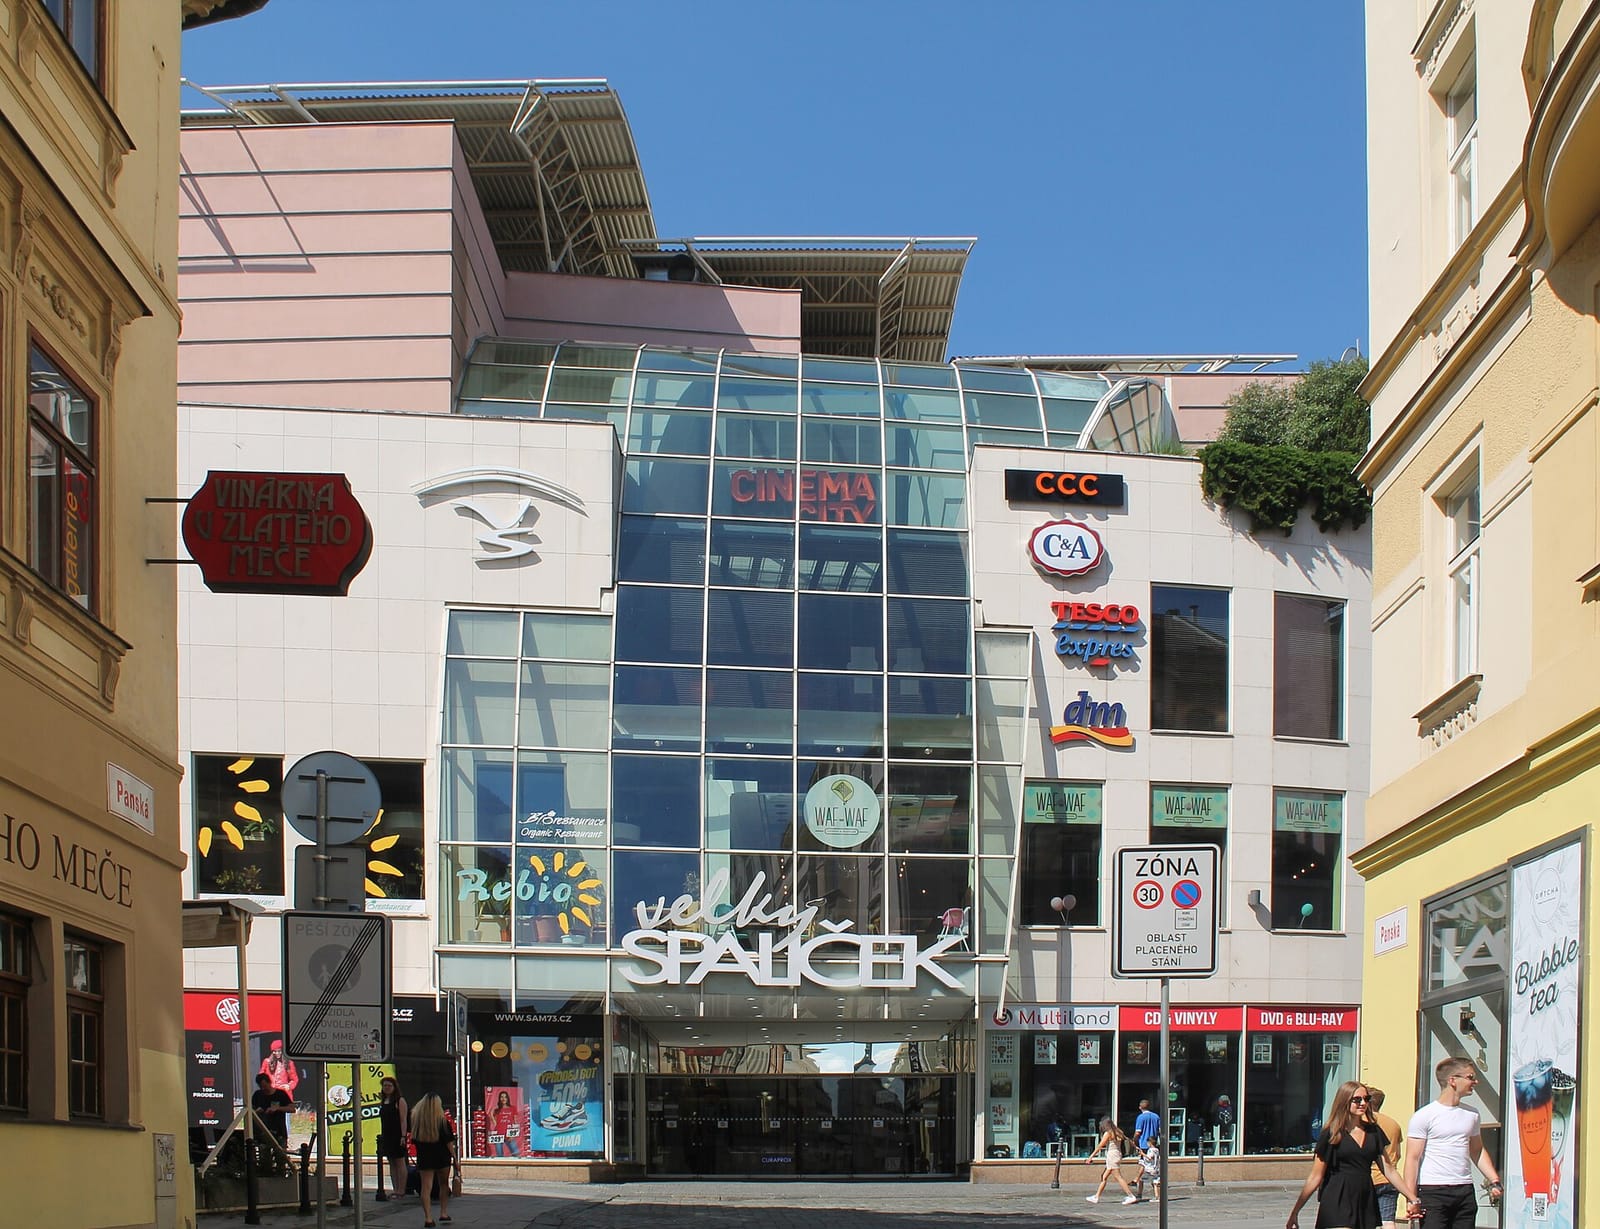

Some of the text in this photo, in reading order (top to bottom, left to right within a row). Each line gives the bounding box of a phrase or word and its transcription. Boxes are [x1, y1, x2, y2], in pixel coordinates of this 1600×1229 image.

[215, 477, 334, 511] VINÁRNA
[731, 469, 876, 502] CINEMA
[1035, 472, 1099, 496] CCC
[221, 510, 350, 544] ZLATÉHO
[64, 491, 80, 596] galerie
[1043, 534, 1091, 560] C&A
[229, 545, 311, 577] MEČE
[1050, 601, 1139, 624] TESCO
[1055, 633, 1134, 663] expres
[1064, 691, 1123, 726] dm
[116, 780, 149, 819] Panská
[815, 807, 868, 827] WAF-WAF
[521, 828, 603, 838] Organic Restaurant
[0, 813, 133, 909] HO MEČE
[1136, 853, 1199, 876] ZÓNA
[456, 869, 572, 902] Rebio
[1140, 888, 1157, 902] 30
[333, 922, 363, 937] ZÓN
[1147, 933, 1187, 943] OBLAST
[1380, 920, 1400, 945] Panská
[1136, 944, 1197, 954] PLACENÉHO
[1151, 956, 1181, 966] STÁNÍ
[1515, 936, 1578, 995] Bubble
[1529, 981, 1559, 1015] tea
[495, 1014, 572, 1023] WWW.SAM73.CZ
[1019, 1010, 1110, 1025] Multiland
[1174, 1011, 1218, 1025] VINYLY
[1260, 1012, 1344, 1026] DVD & BLU-RAY
[552, 1136, 580, 1149] PUMA
